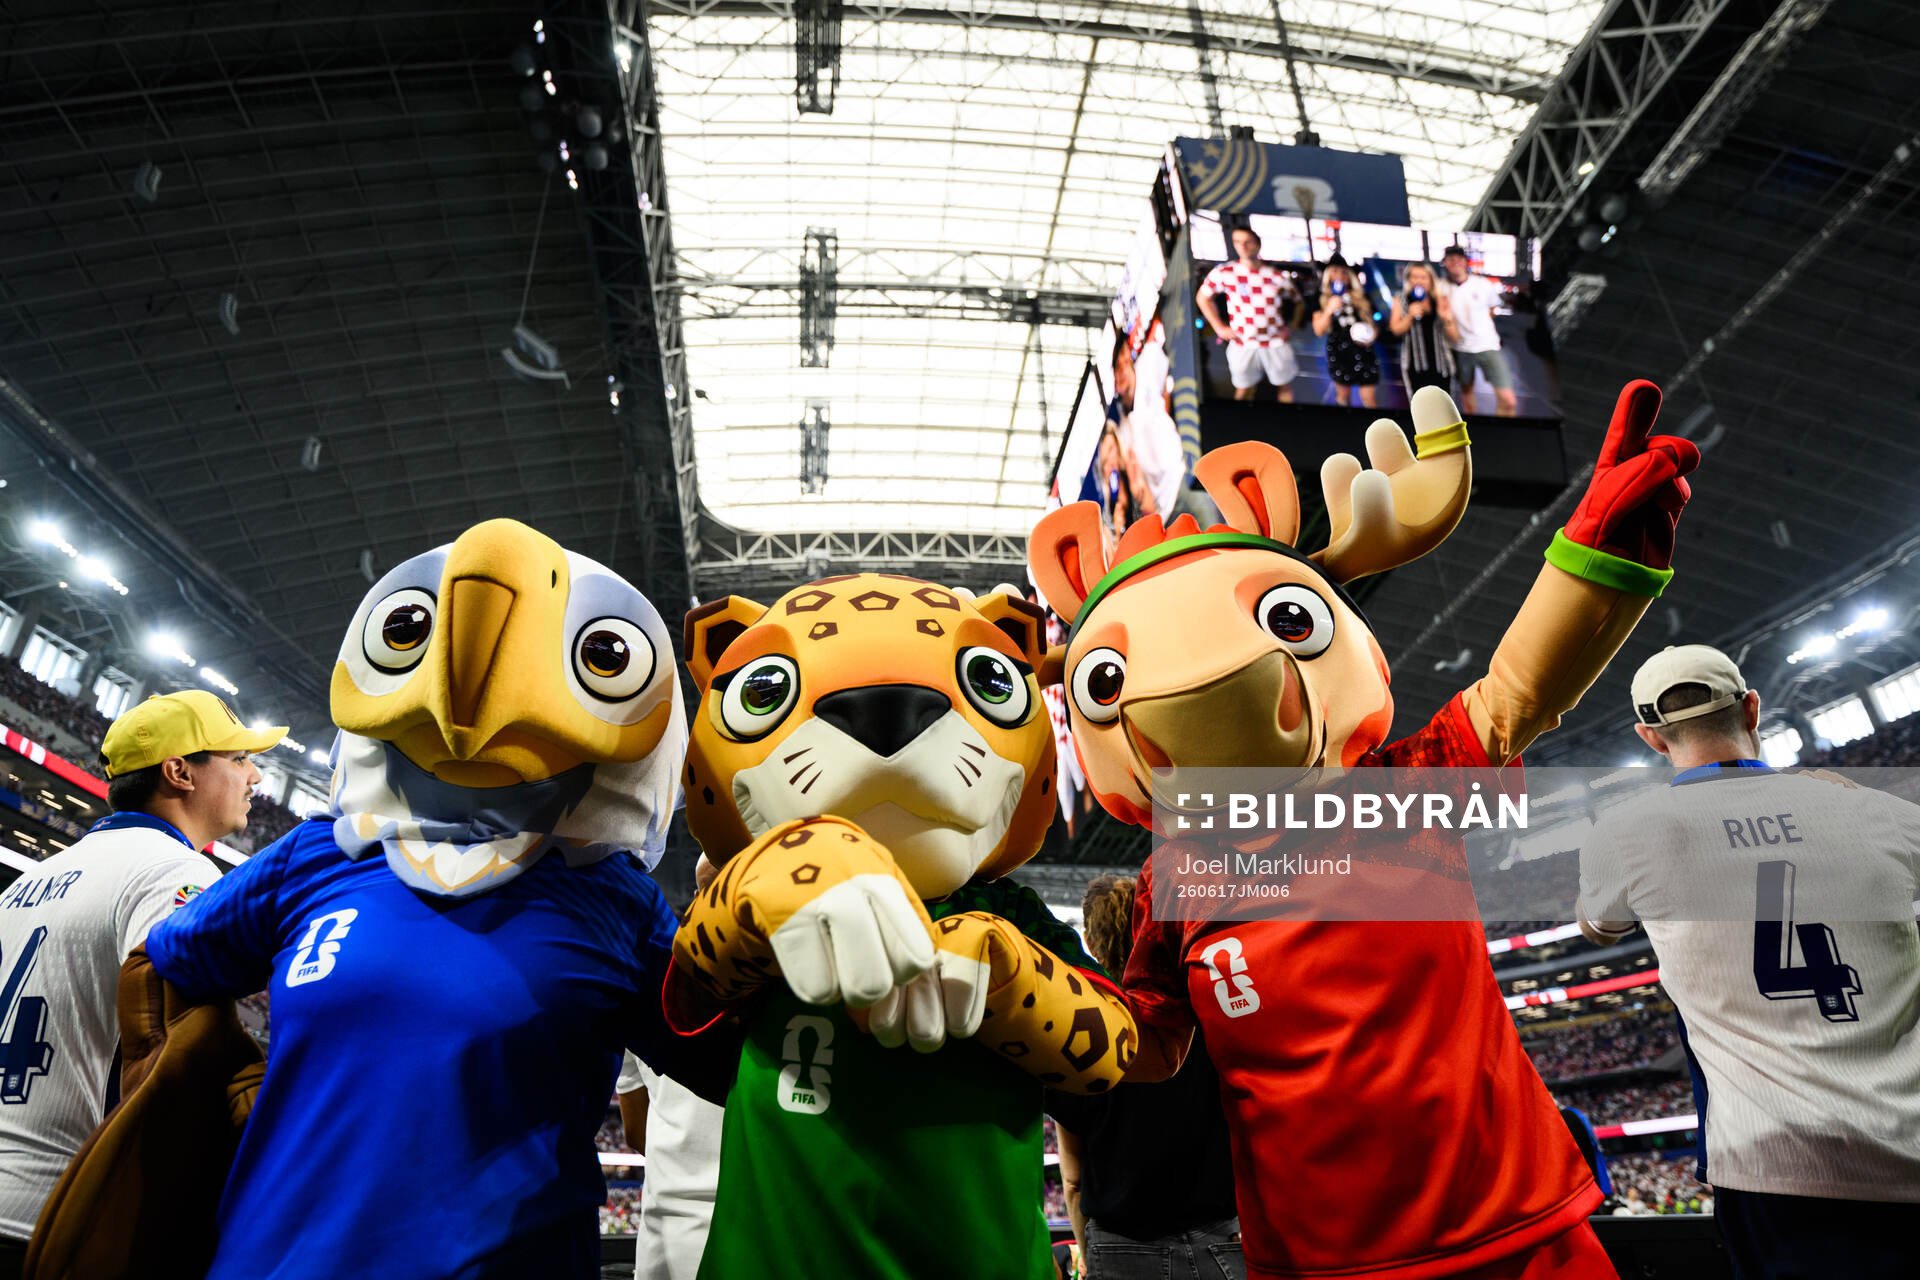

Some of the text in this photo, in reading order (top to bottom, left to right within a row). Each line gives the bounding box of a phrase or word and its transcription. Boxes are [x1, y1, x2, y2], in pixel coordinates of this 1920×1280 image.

[1722, 813, 1803, 848] RICE
[1753, 860, 1863, 1023] 4
[296, 965, 319, 978] FIFA
[0, 925, 54, 1104] 4
[1230, 998, 1250, 1011] FIFA
[791, 1092, 816, 1105] FIFA
